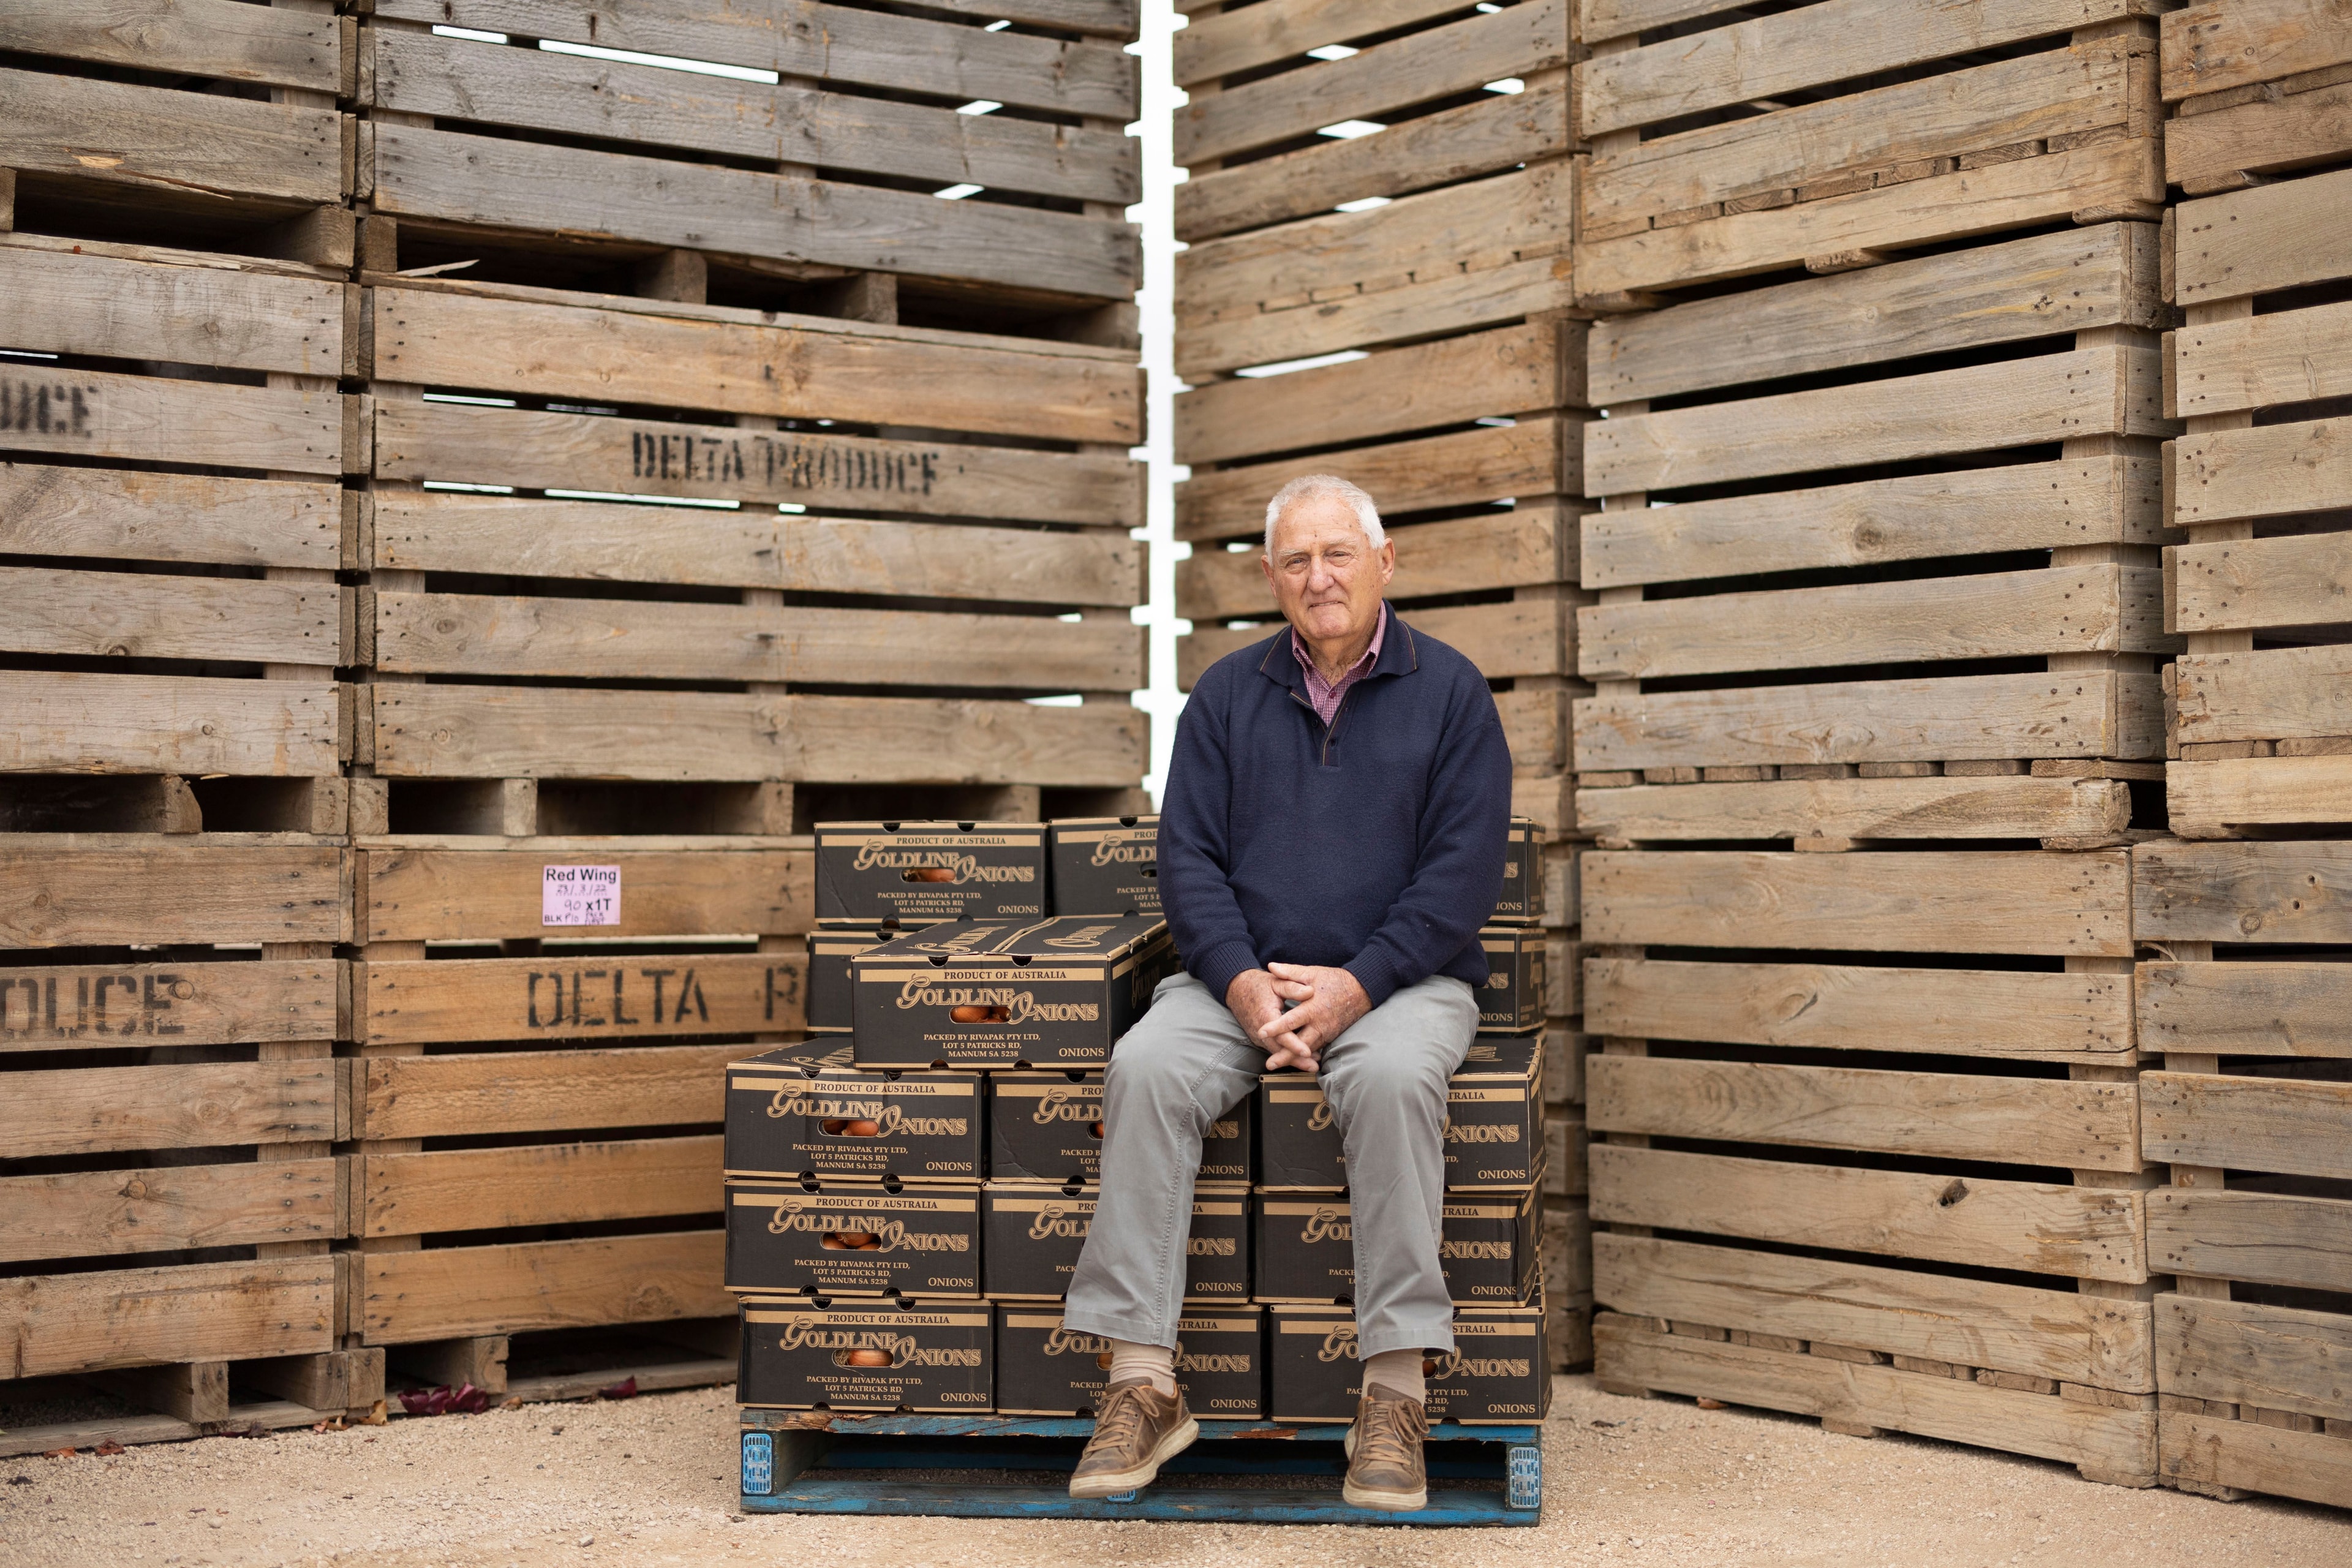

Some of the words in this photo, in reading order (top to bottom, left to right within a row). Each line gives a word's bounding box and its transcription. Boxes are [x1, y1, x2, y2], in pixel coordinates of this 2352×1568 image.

[633, 432, 744, 481] DELTA
[1091, 834, 1156, 866] GOLD
[853, 839, 960, 870] GOLDLINE
[952, 855, 1035, 884] ONIONS
[546, 868, 575, 881] Red
[580, 868, 616, 884] Wing
[586, 899, 611, 910] x1T
[1496, 902, 1522, 910] IONS
[529, 967, 709, 1027] DELTA
[895, 973, 1014, 1009] GOLDLINE
[1008, 991, 1099, 1025] ONIONS
[1479, 1013, 1513, 1022] NIONS
[1059, 1048, 1104, 1057] ONIONS
[814, 1083, 862, 1091] PRODUCT
[767, 1083, 884, 1117] GOLDLINE
[875, 1105, 967, 1138] ONIONS
[1033, 1088, 1102, 1124] GOLD
[927, 1162, 971, 1170] ONIONS
[1198, 1165, 1244, 1174] ONIONS
[1478, 1170, 1525, 1178] ONIONS
[768, 1199, 886, 1234] GOLDLINE
[877, 1220, 969, 1253] ONIONS
[1186, 1238, 1235, 1255] IONS
[929, 1278, 973, 1287] ONIONS
[1196, 1283, 1242, 1291] ONIONS
[1471, 1286, 1517, 1295] ONIONS
[779, 1316, 897, 1350] GOLDLINE
[889, 1335, 981, 1369] ONIONS
[1043, 1320, 1114, 1355] GOLD
[941, 1393, 986, 1401] ONIONS
[1211, 1400, 1256, 1408] ONIONS
[1488, 1404, 1535, 1413] ONIONS
